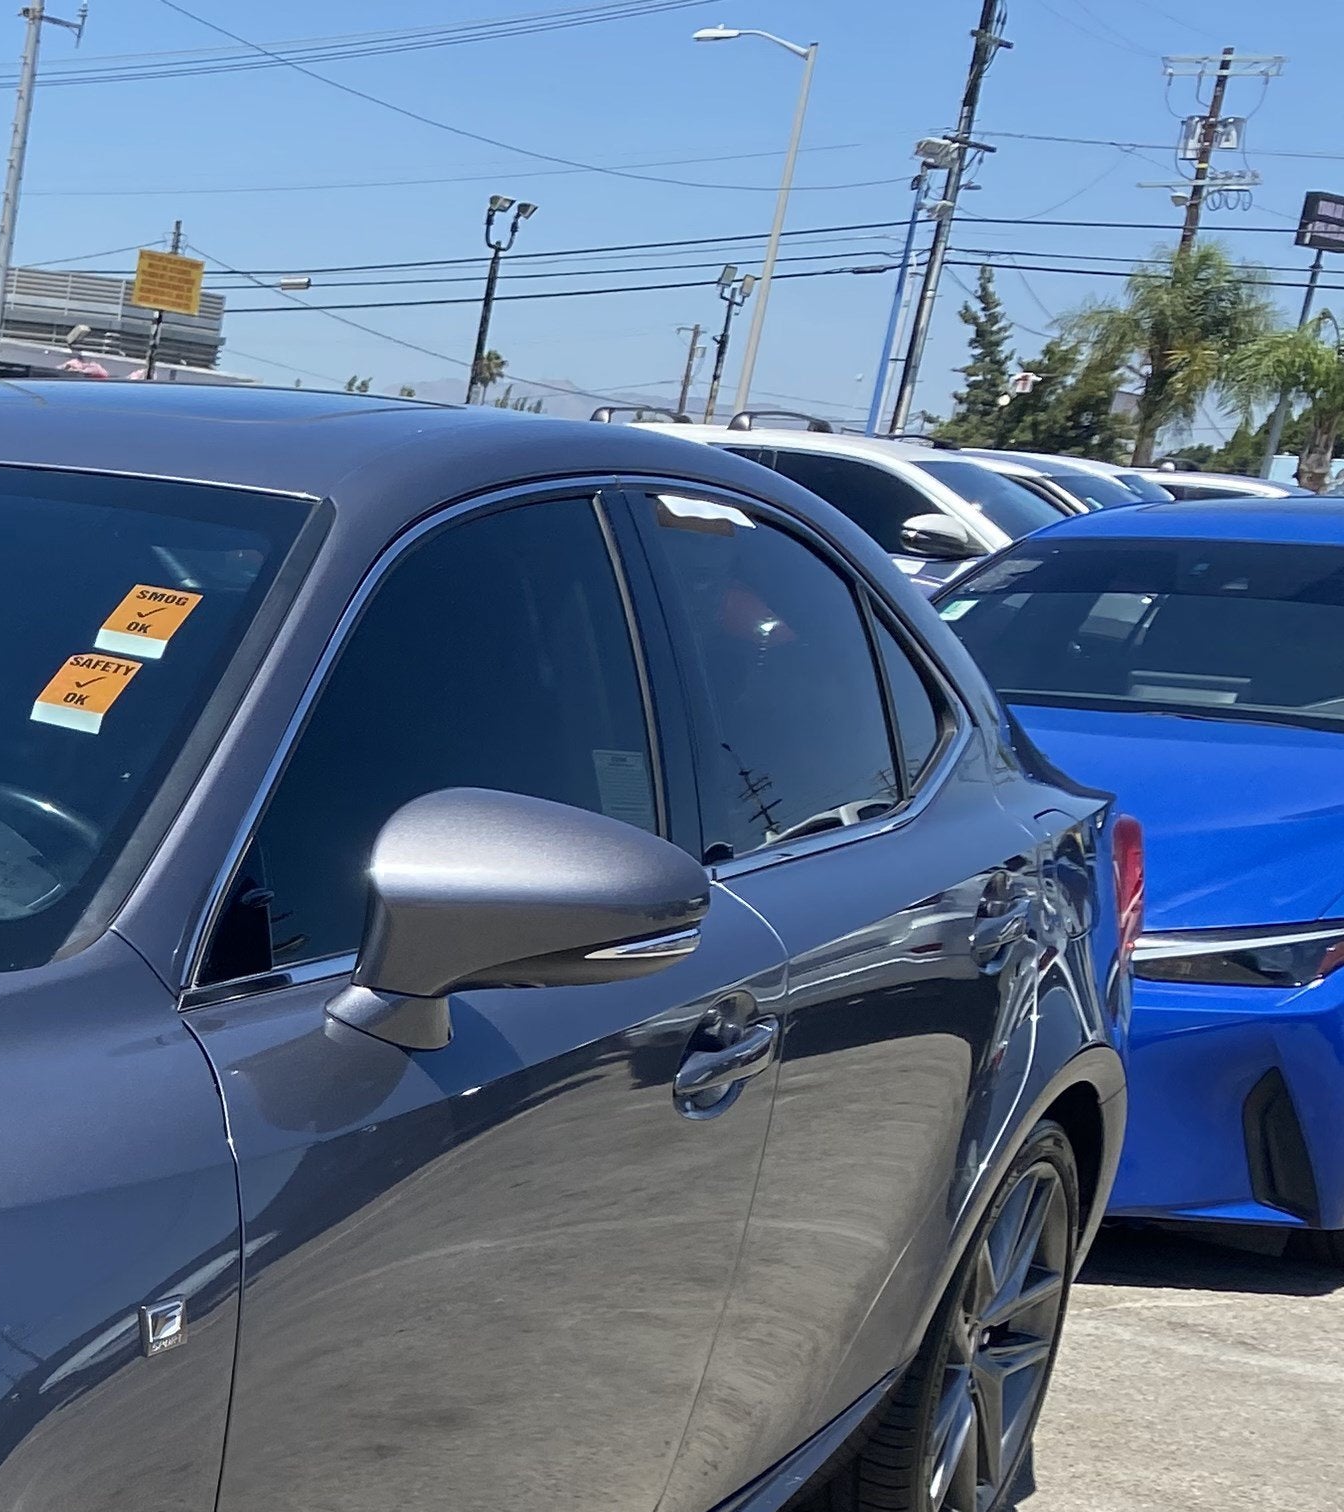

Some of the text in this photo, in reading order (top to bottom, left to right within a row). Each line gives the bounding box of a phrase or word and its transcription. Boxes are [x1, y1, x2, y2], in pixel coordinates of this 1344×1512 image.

[135, 589, 189, 607] SMOG
[125, 621, 151, 634] OK
[69, 656, 136, 676] SAFETY
[63, 692, 90, 706] OK
